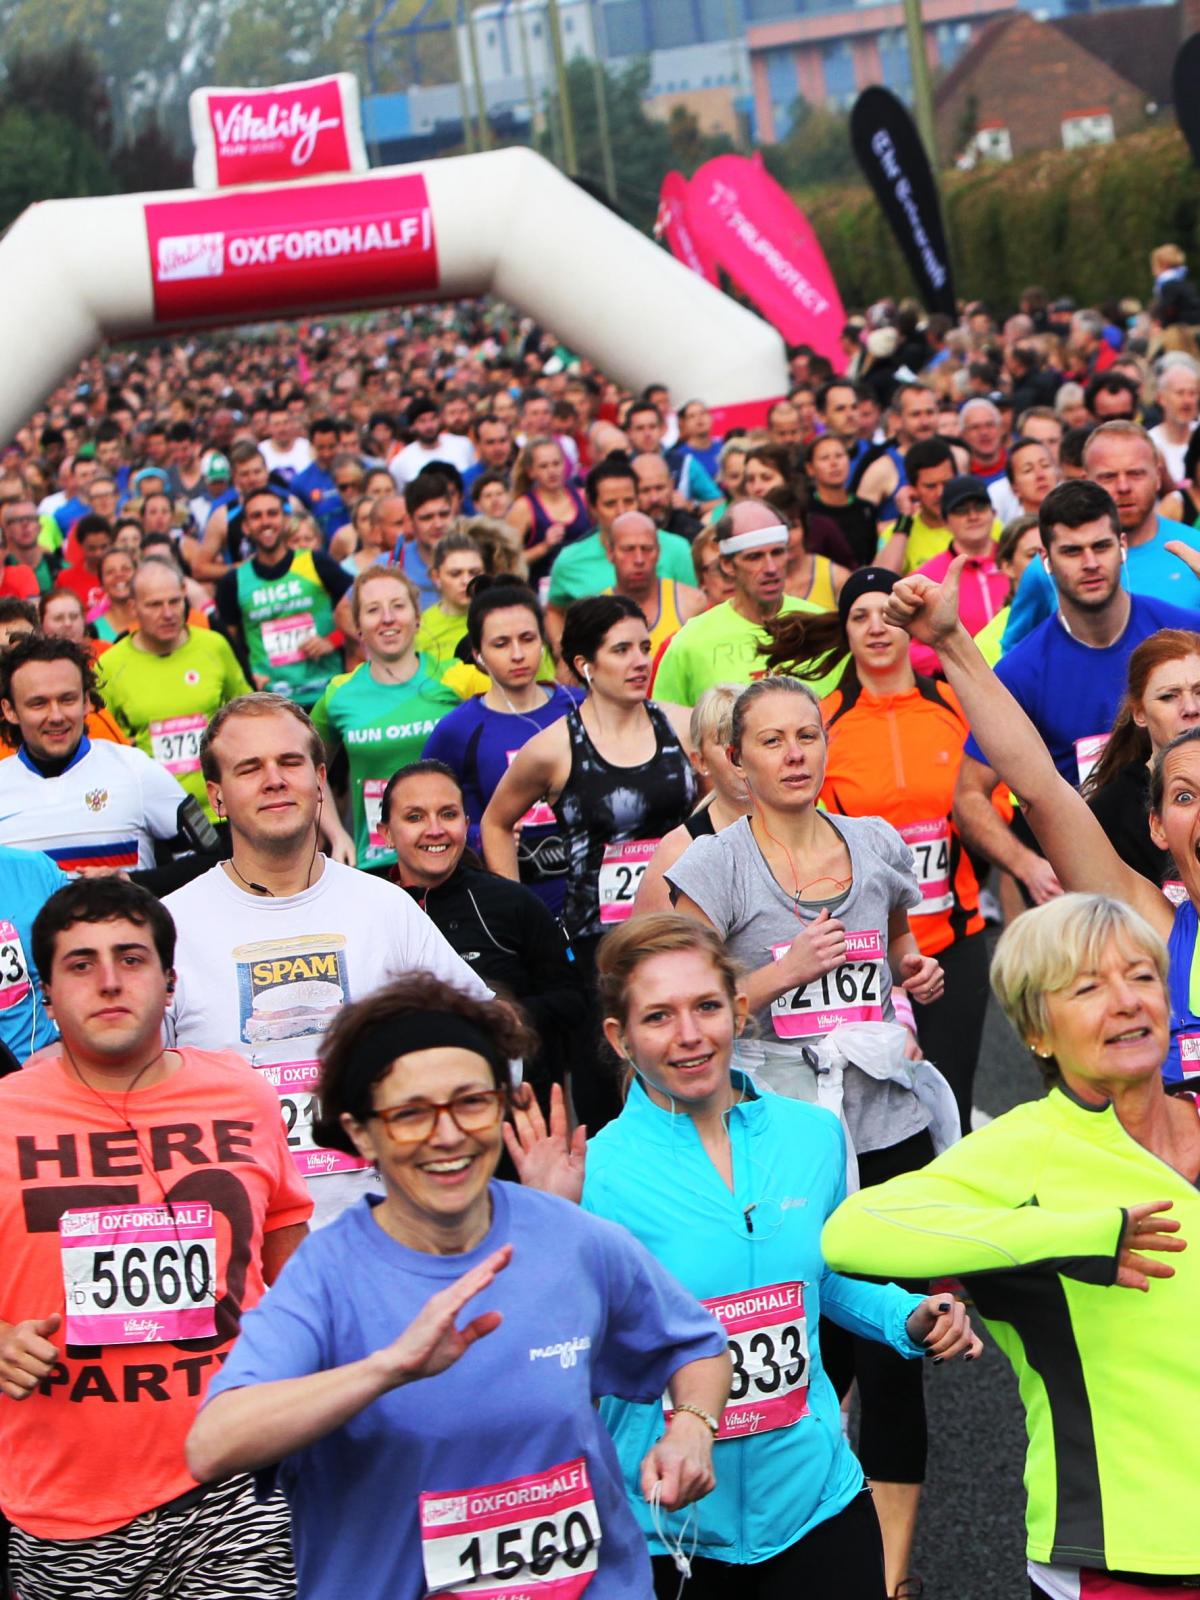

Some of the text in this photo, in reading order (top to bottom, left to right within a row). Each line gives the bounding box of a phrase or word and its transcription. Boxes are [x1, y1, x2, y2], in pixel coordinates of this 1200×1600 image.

[213, 101, 340, 166] Vitality
[228, 216, 419, 266] OXFORDHALF
[252, 581, 302, 607] NICK
[347, 728, 381, 743] RUN
[624, 843, 657, 855] OXFOR
[915, 840, 949, 879] 74
[616, 866, 646, 901] 2
[0, 945, 24, 985] 3
[253, 954, 338, 986] SPAM
[790, 962, 878, 1010] 2162
[16, 1119, 257, 1180] HERE
[307, 1154, 341, 1172] Vitality
[92, 1243, 210, 1309] 5660
[709, 1288, 796, 1322] FORDHALF
[38, 1351, 231, 1403] PART
[724, 1411, 767, 1432] Vitality
[469, 1470, 580, 1515] OXFORDHALF
[458, 1510, 594, 1583] 1560
